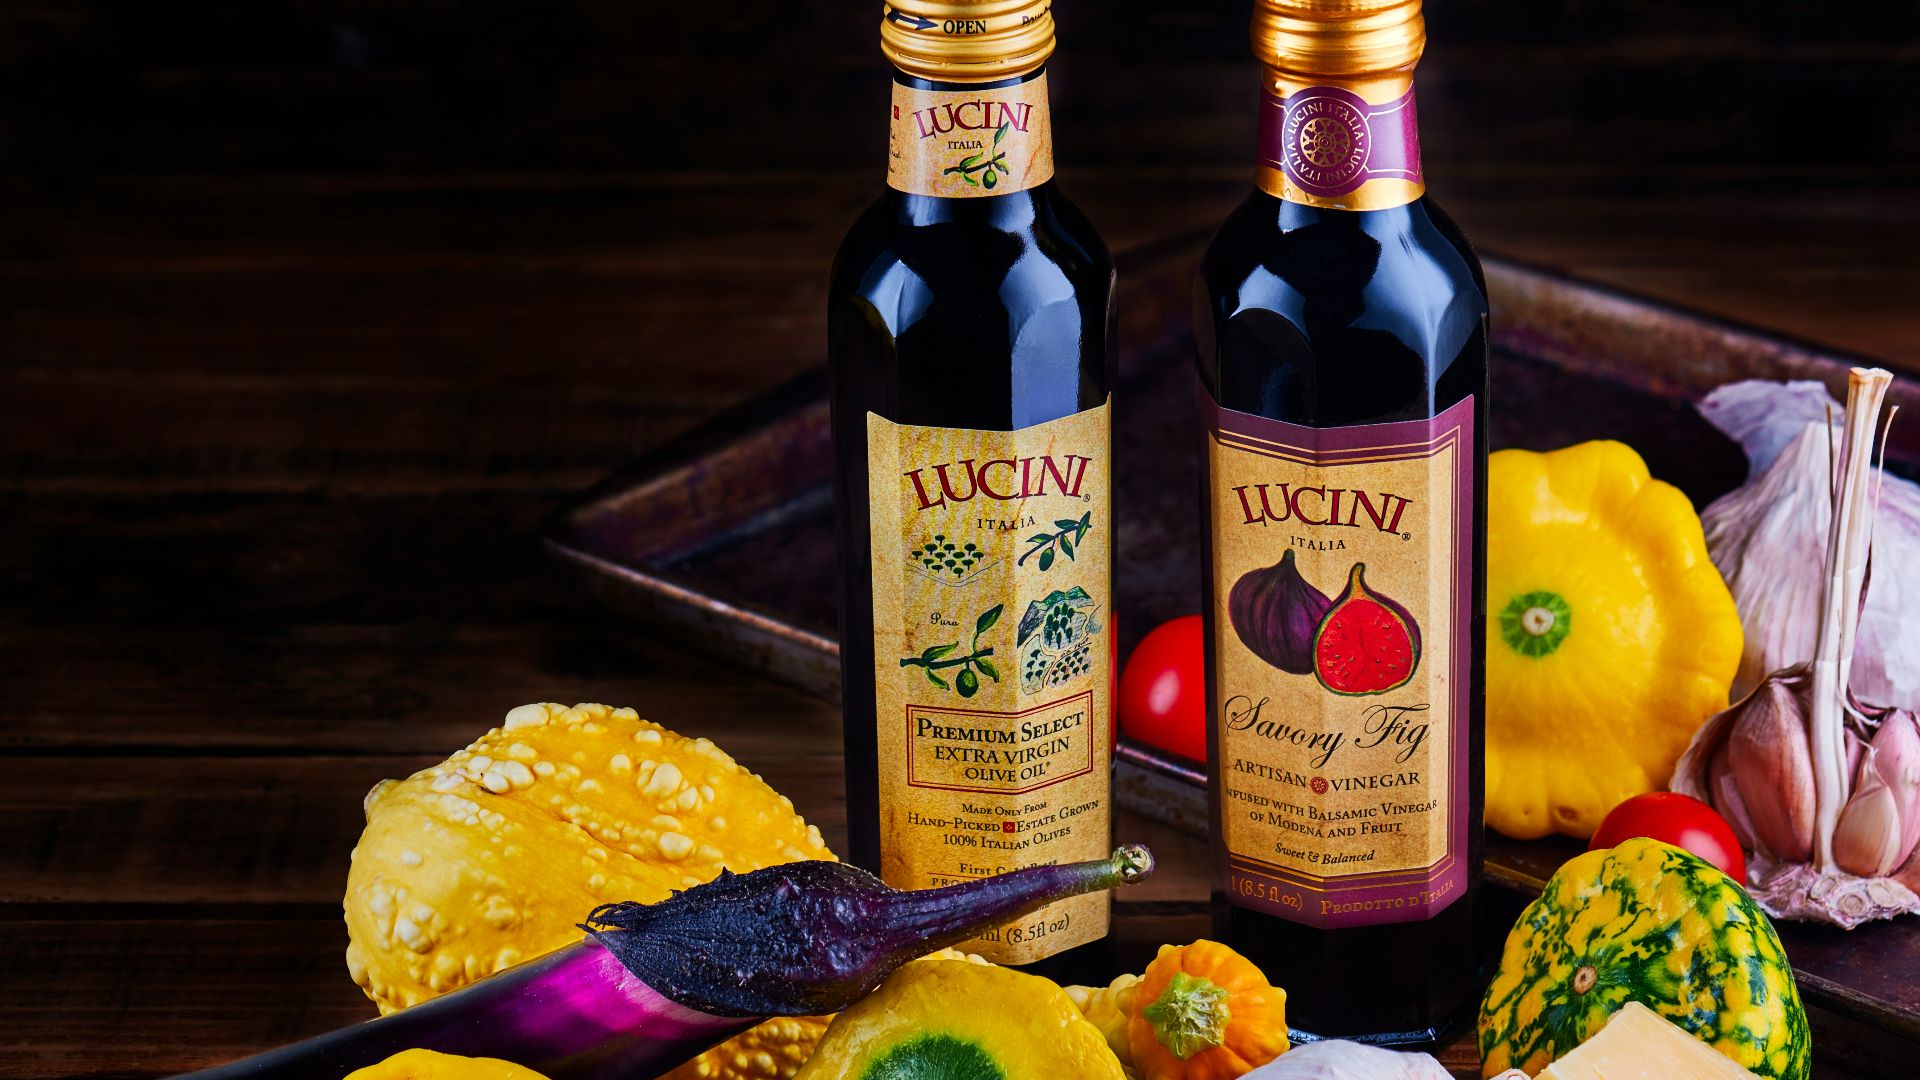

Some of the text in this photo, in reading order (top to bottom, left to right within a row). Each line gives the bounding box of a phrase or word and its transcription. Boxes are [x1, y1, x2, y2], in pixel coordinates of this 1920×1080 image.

[943, 20, 987, 35] OPEN
[912, 99, 1034, 140] LUCINI
[947, 141, 984, 151] ITALIA
[977, 516, 1036, 530] ITALIA
[1290, 535, 1346, 551] ITALIA
[1224, 695, 1431, 769] Savory Fig
[935, 736, 1070, 766] EXTRA VIRGIN
[965, 767, 1017, 783] OLIVE
[1234, 758, 1420, 792] ARTISAN VINEGAR
[943, 833, 978, 848] 100%
[1275, 842, 1376, 866] Sweet & Balanced
[960, 862, 992, 876] First
[1239, 878, 1266, 898] (8.5
